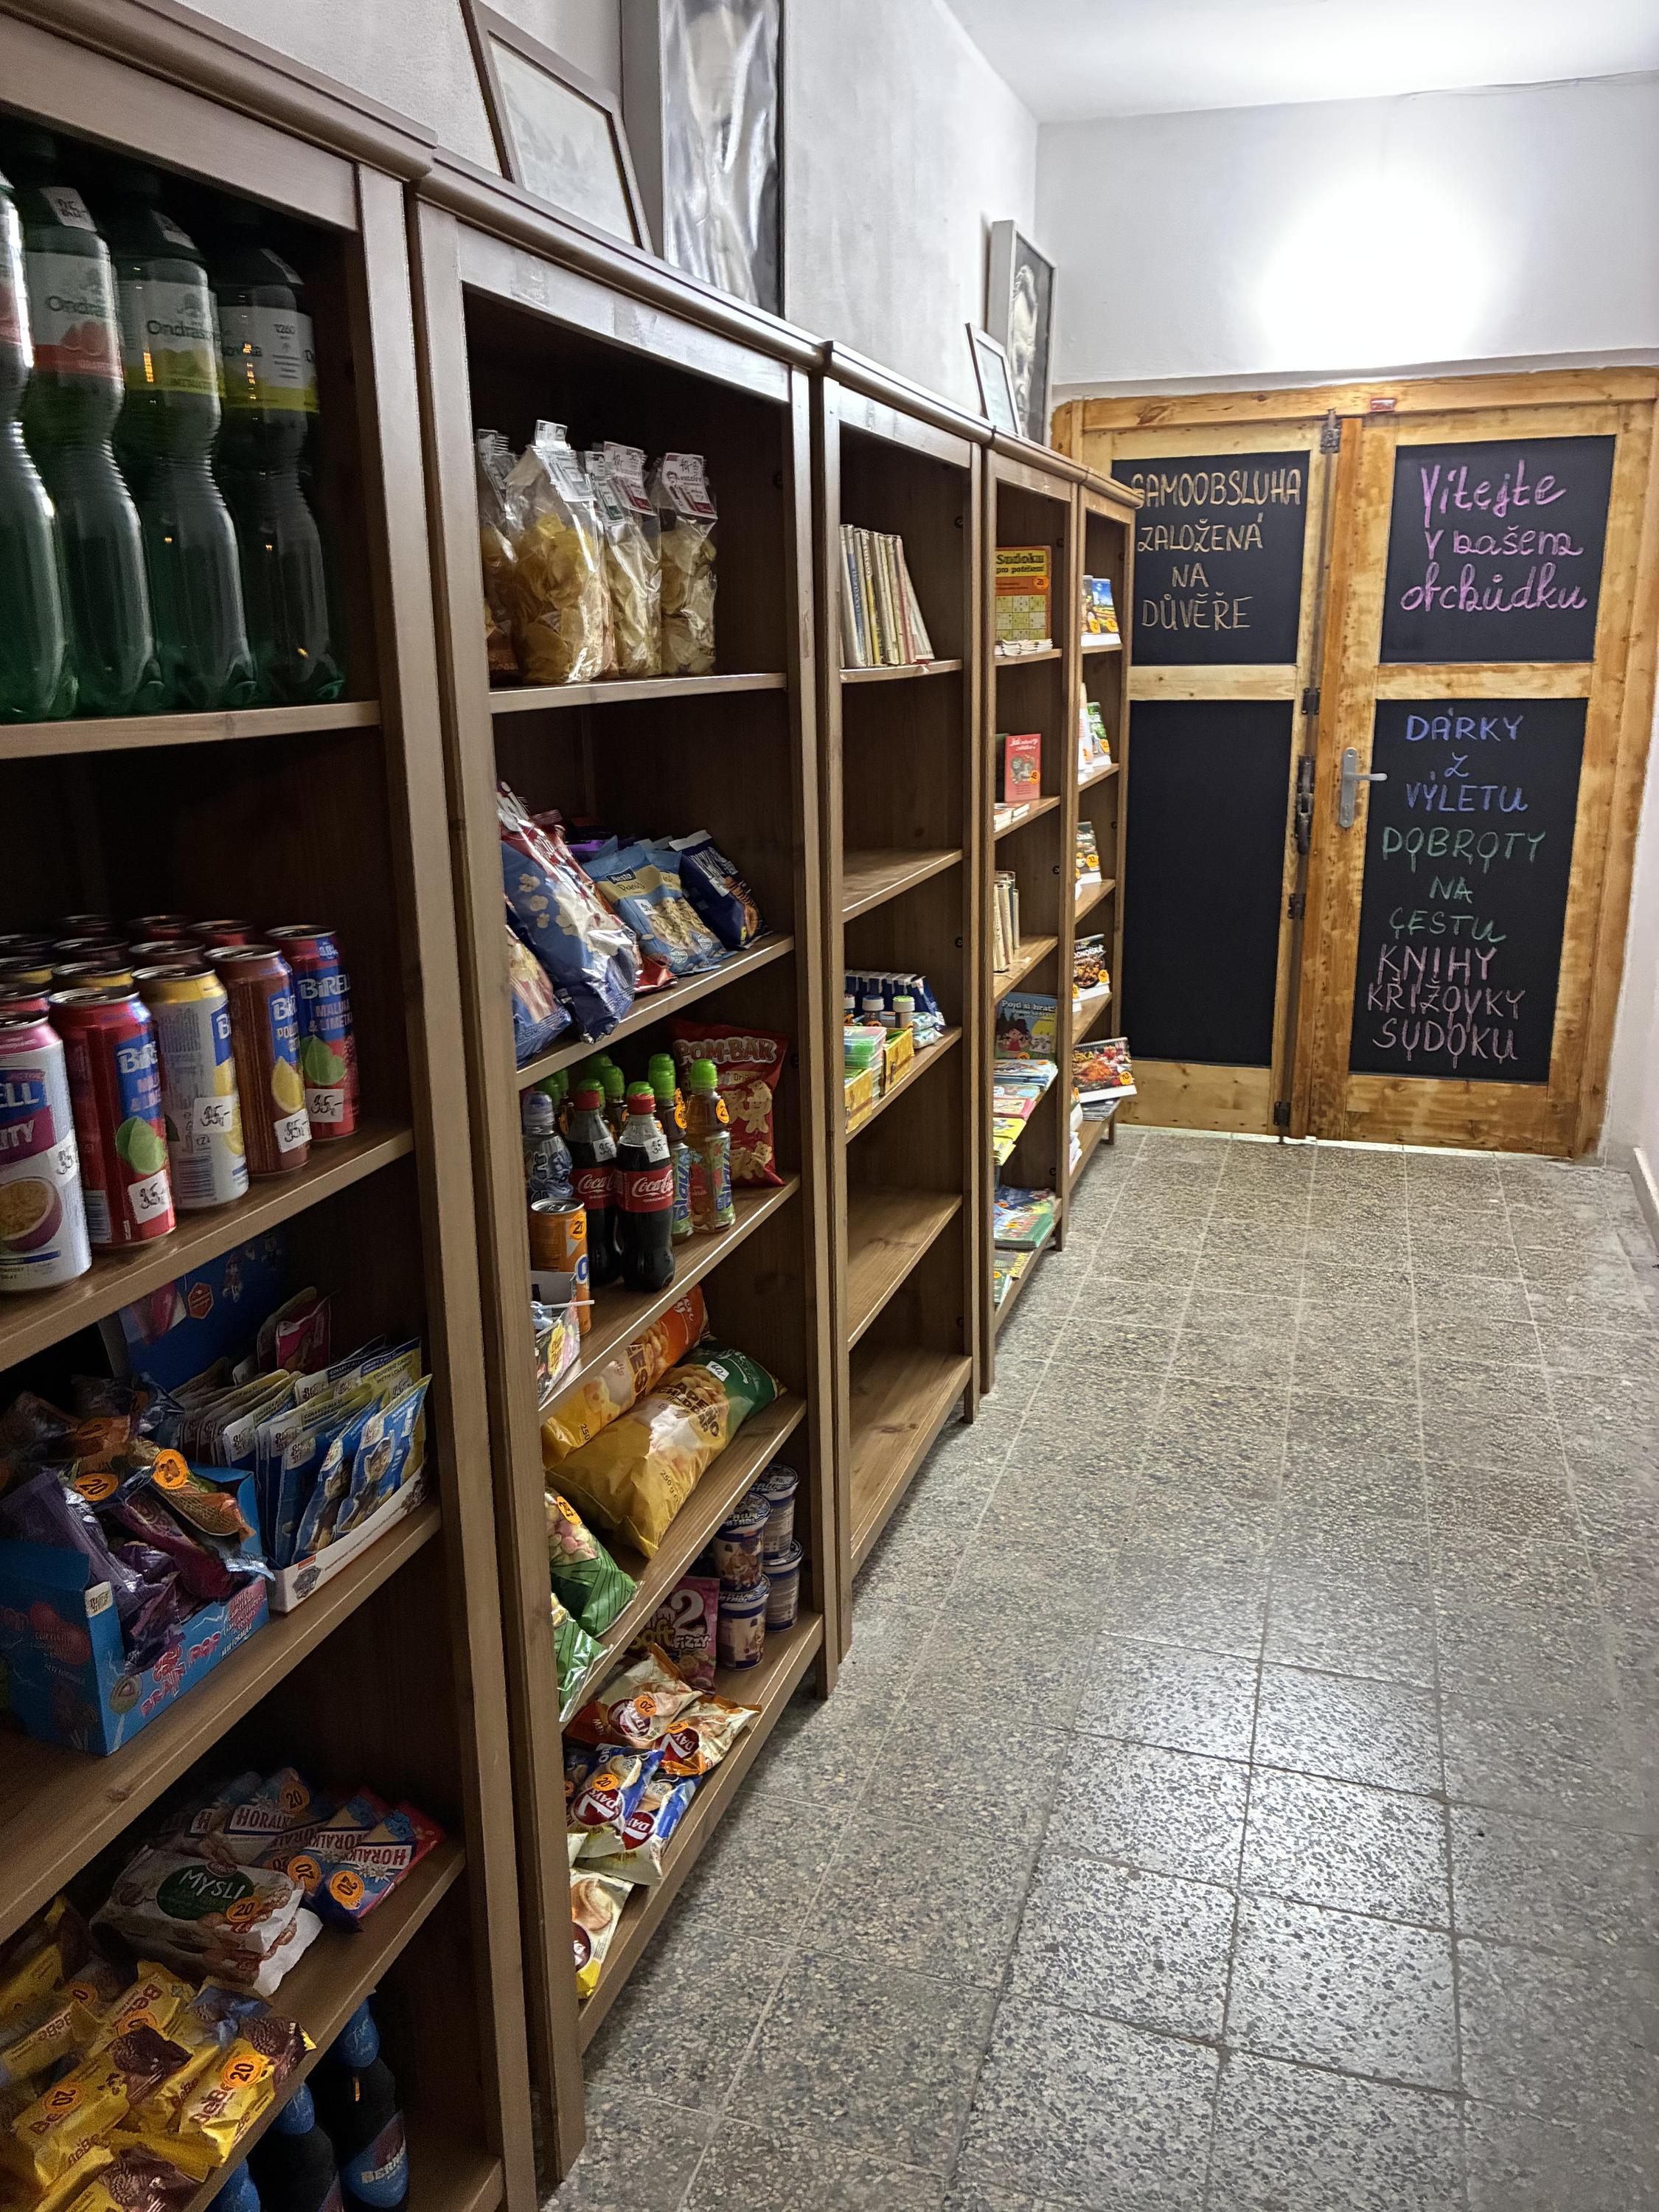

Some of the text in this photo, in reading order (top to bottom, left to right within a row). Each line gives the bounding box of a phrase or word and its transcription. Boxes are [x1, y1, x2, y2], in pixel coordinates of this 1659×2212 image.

[1131, 467, 1302, 508] SAMOOBSLUHA
[1138, 514, 1263, 552] ZALOŽENÁ
[1453, 524, 1584, 557] našem
[996, 553, 1044, 565] Sudoku
[1171, 563, 1210, 588] NA
[1401, 562, 1587, 613] obchůdku
[1141, 592, 1253, 630] DŮVĚŘE
[1405, 707, 1523, 742] DÁRKY
[1381, 827, 1546, 874] DOBROTY
[1429, 876, 1473, 903] NA
[1389, 907, 1506, 943] CESTU
[1377, 944, 1498, 987] KNIHY
[1372, 1018, 1519, 1068] SUDOKU
[80, 1479, 108, 1495] 20
[234, 1902, 254, 1916] 20
[229, 2062, 254, 2082] 20
[51, 2087, 77, 2107] 20
